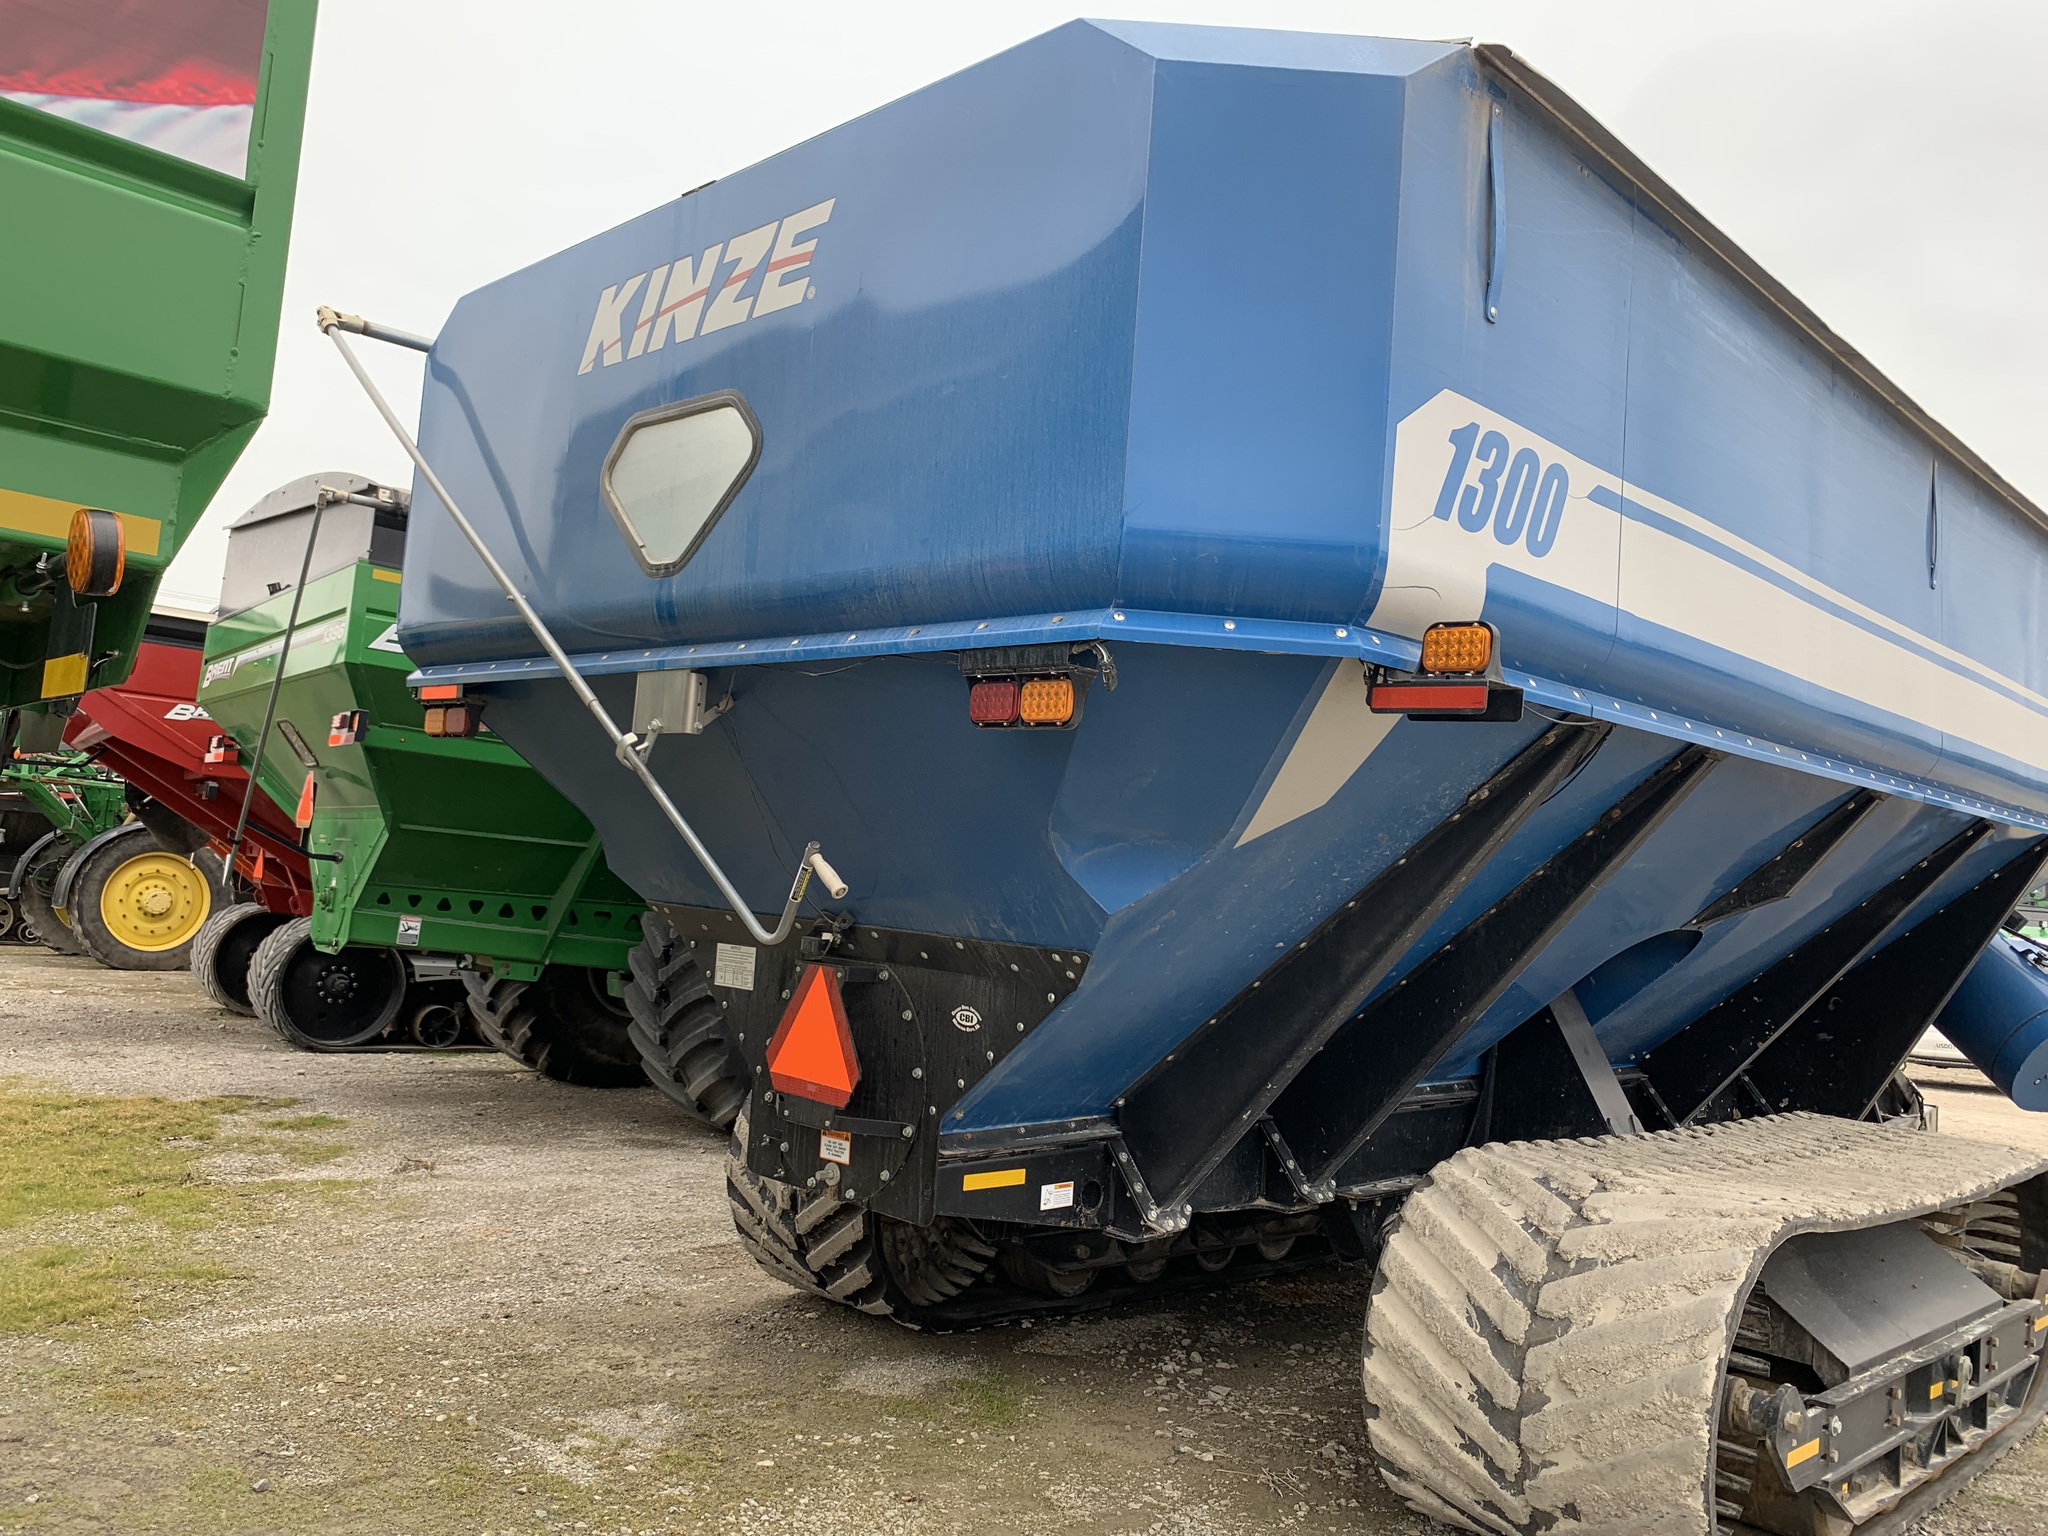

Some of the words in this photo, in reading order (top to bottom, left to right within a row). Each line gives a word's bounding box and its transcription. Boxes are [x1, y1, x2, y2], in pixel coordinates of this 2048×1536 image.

[577, 197, 836, 375] KINZE
[1433, 421, 1569, 558] 1300
[959, 1013, 974, 1024] CBI
